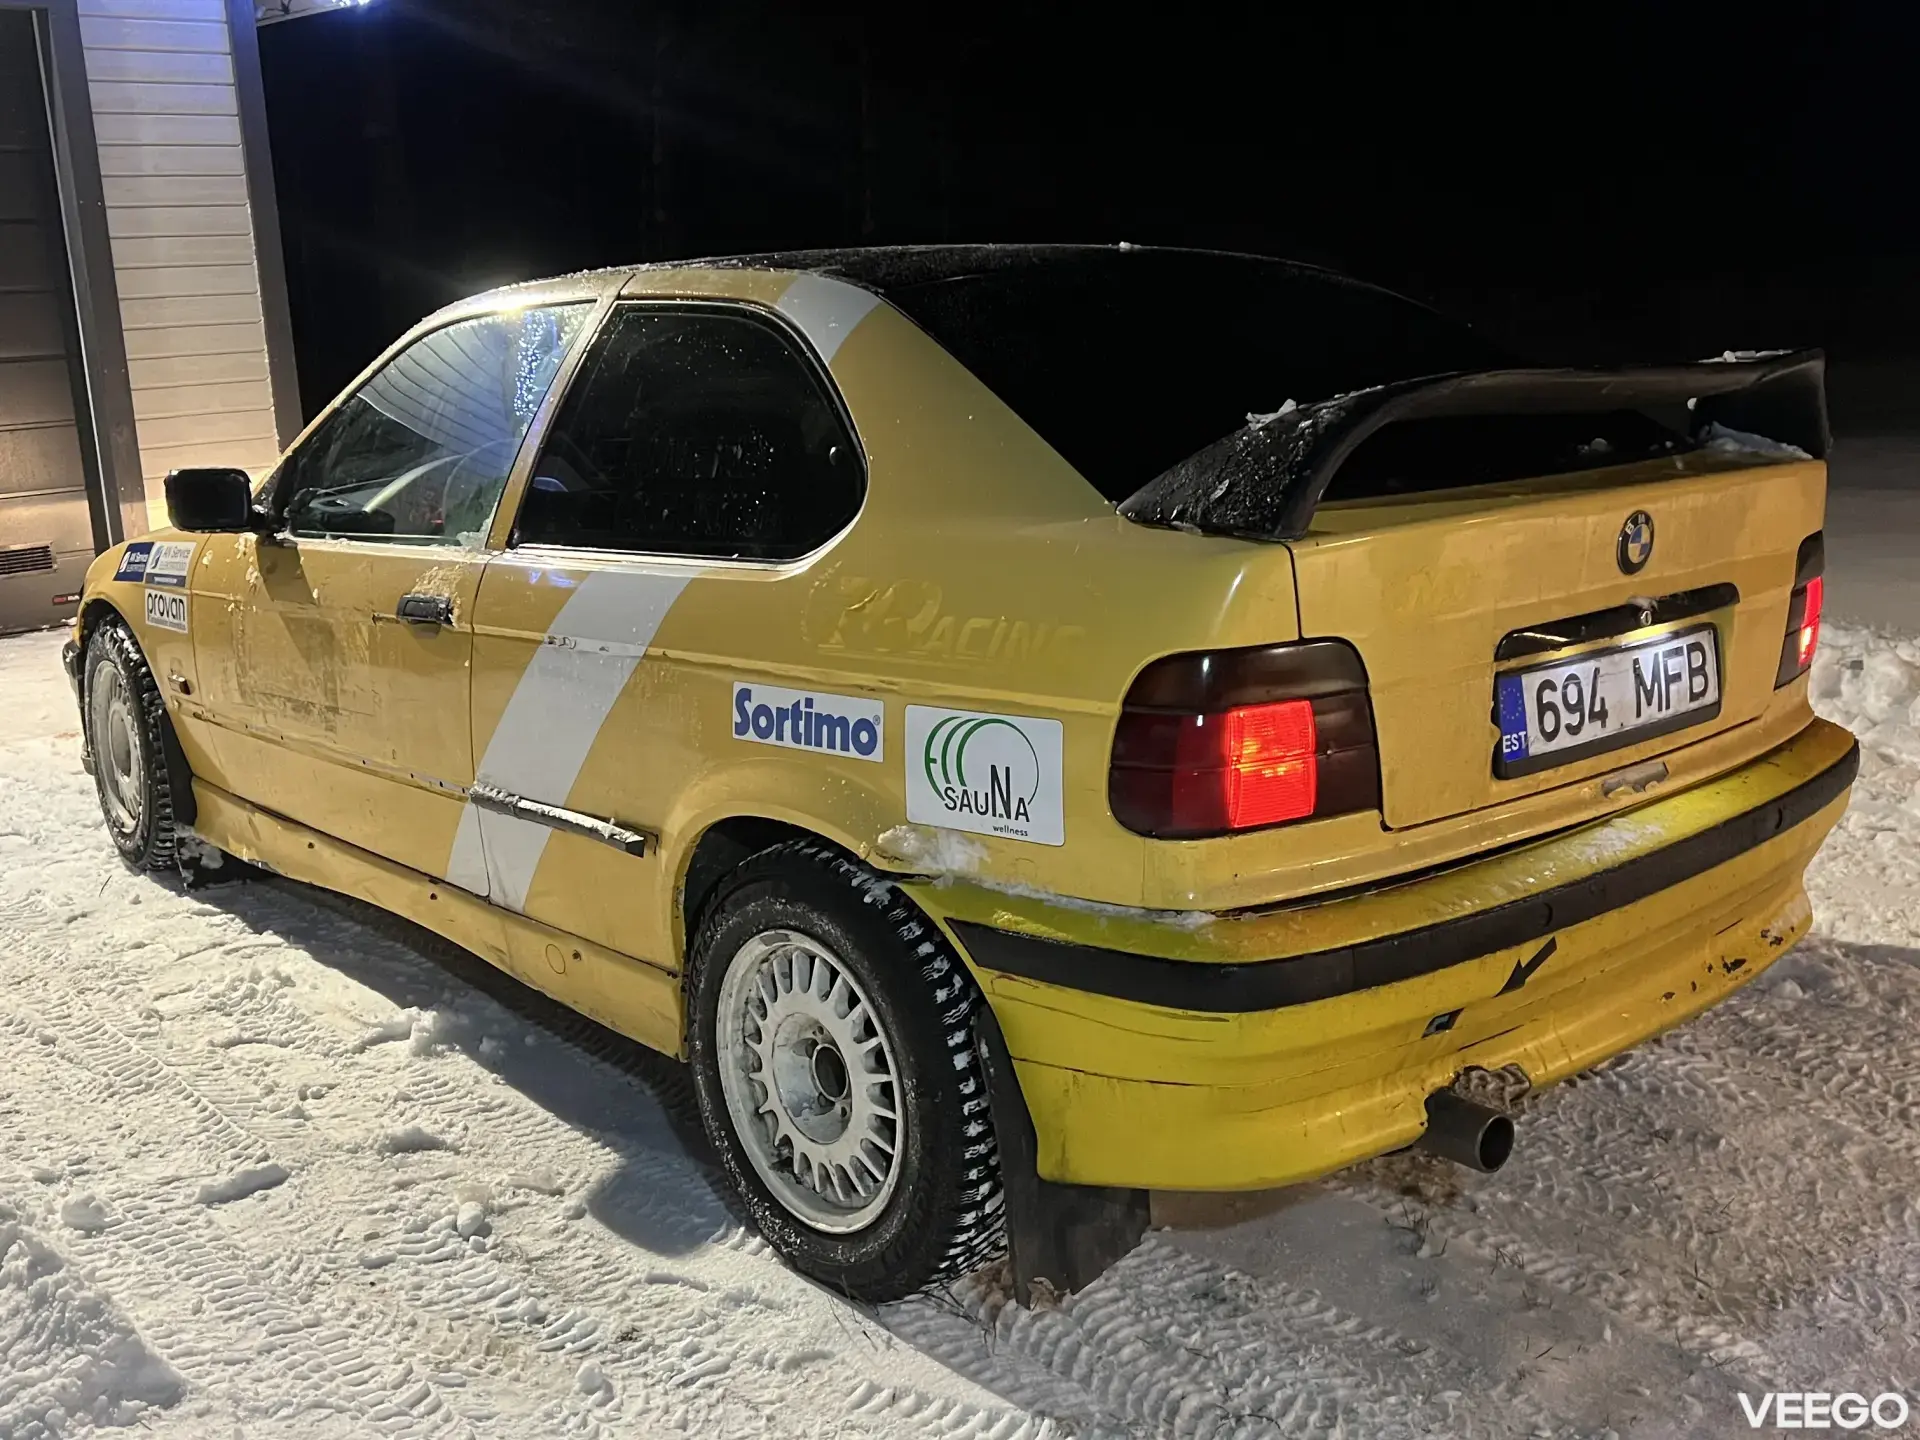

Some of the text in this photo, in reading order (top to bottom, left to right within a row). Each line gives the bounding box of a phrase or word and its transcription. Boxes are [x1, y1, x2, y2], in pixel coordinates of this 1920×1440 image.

[146, 592, 186, 622] provan
[1535, 641, 1709, 743] 694 MFB
[1502, 730, 1528, 754] EST
[992, 824, 1029, 837] wellness
